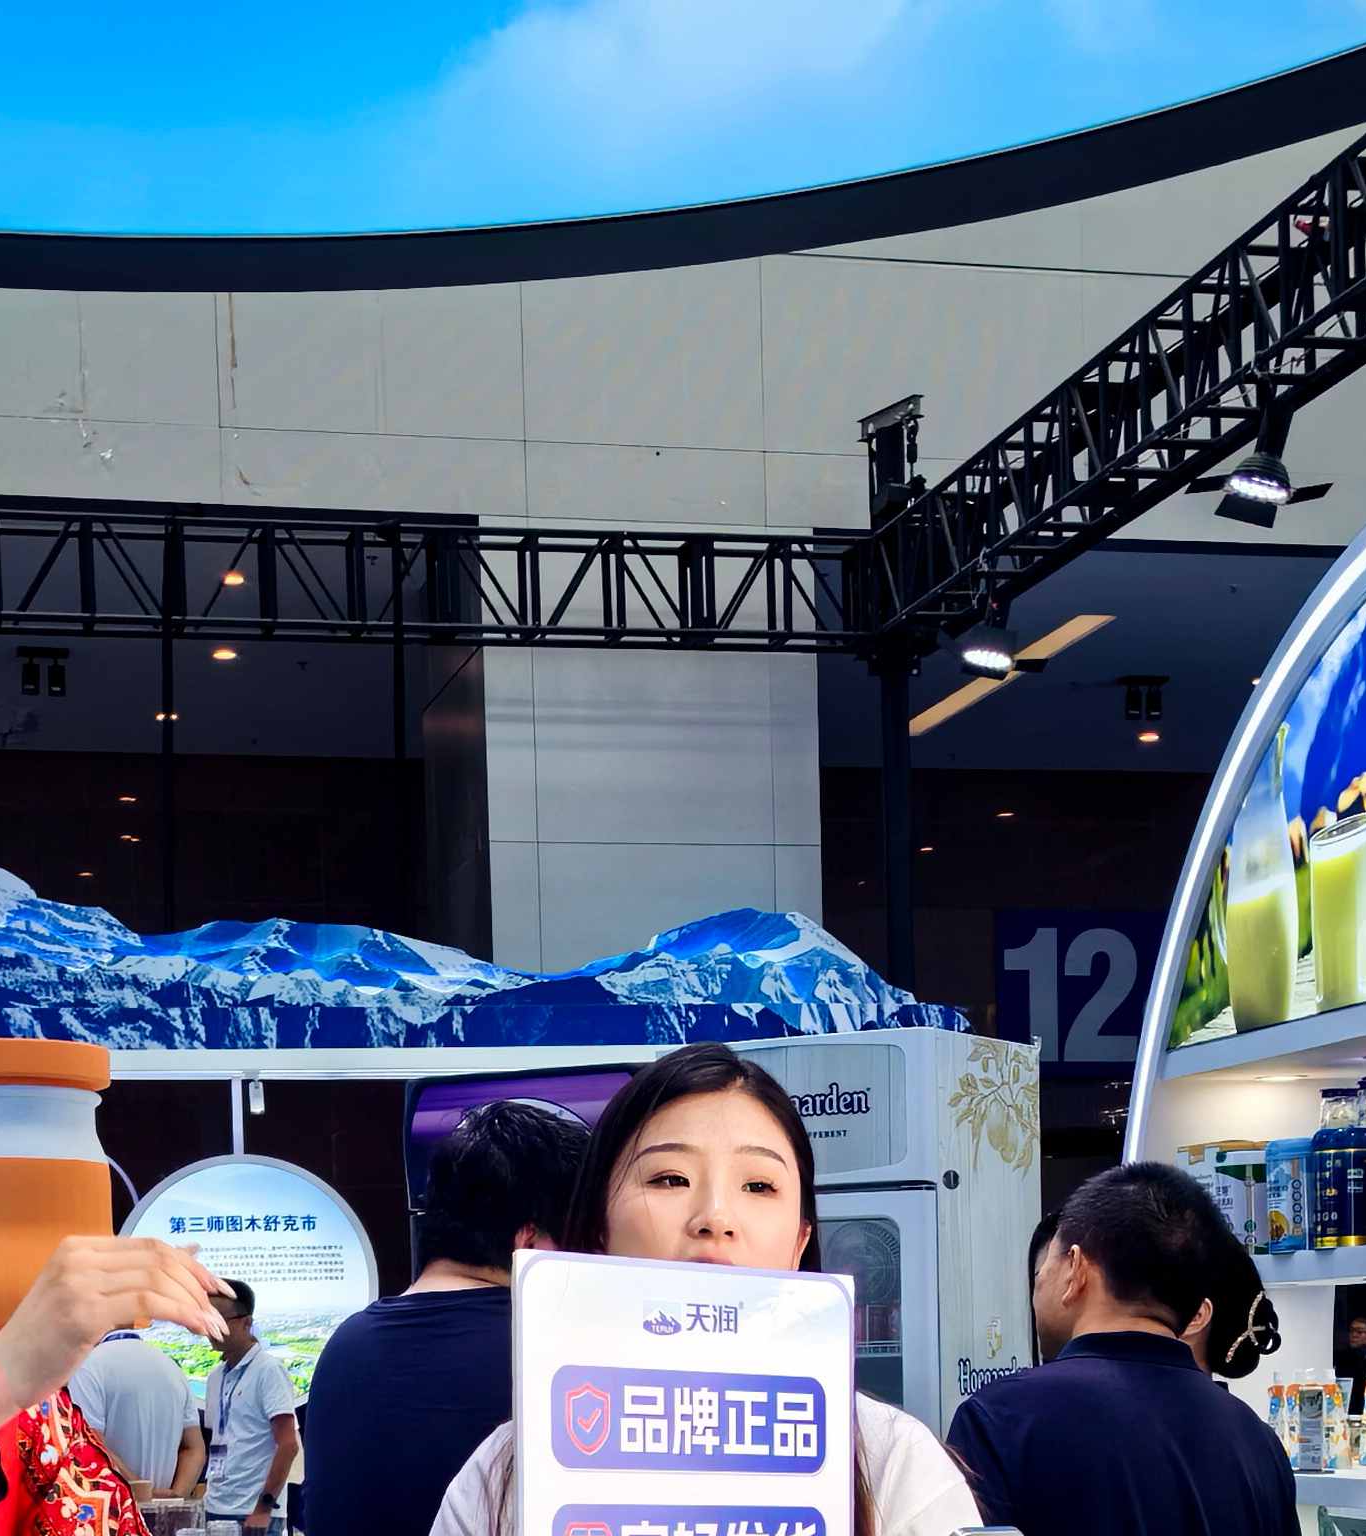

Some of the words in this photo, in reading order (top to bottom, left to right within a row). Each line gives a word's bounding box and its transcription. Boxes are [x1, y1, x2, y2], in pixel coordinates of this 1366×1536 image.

[1004, 927, 1137, 1063] 12
[170, 1214, 318, 1235] 第三师图木舒克市
[686, 1303, 738, 1334] 天润
[620, 1384, 818, 1459] 品牌正品
